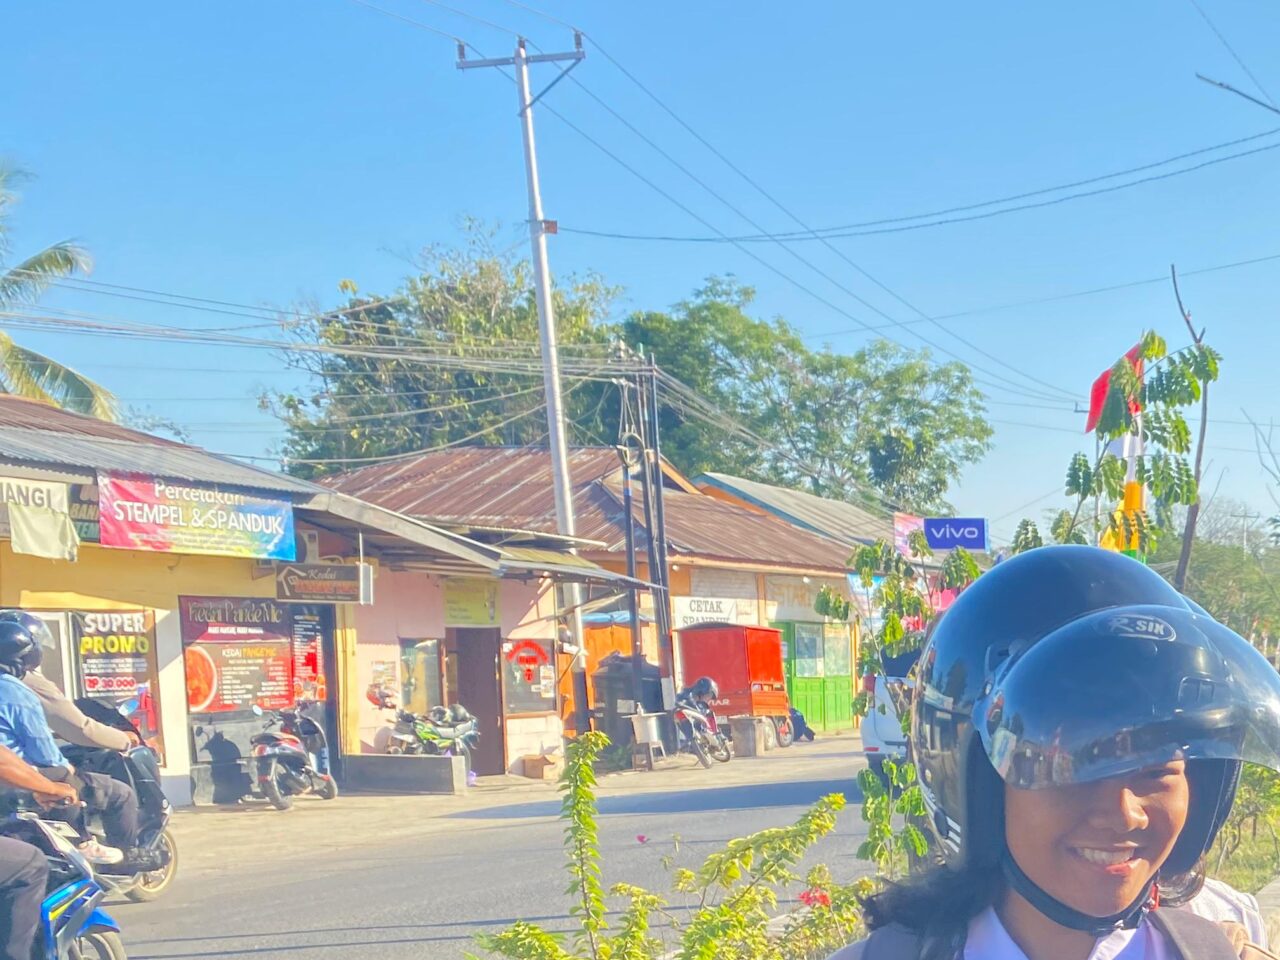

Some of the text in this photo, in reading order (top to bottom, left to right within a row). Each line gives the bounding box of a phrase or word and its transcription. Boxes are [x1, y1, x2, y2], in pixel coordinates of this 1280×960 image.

[154, 478, 245, 506] Percetakan
[113, 500, 285, 534] STEMPEL & SPANDUK
[931, 524, 979, 538] vivo
[690, 599, 723, 613] CETAK
[84, 613, 147, 633] SUPER
[80, 635, 149, 655] PROMO
